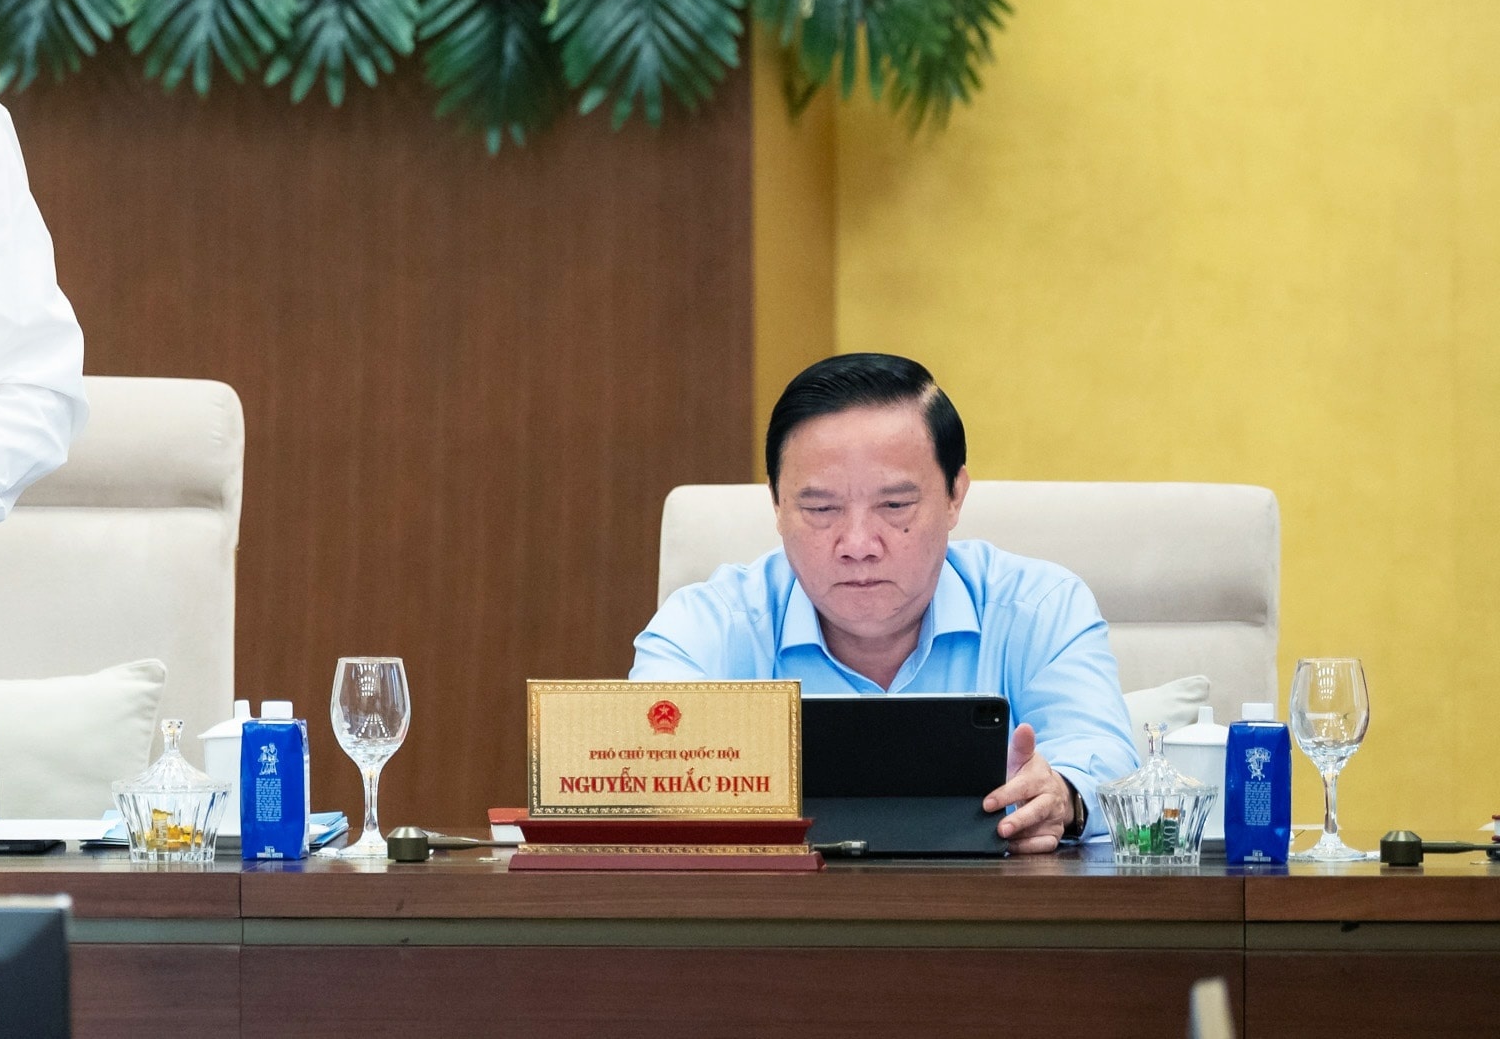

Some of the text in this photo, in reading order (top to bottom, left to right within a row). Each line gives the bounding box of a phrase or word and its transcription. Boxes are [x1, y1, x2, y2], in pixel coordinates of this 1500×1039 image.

[589, 746, 741, 762] PHÓ CHỦ TỊCH QUỐC HỘI
[559, 766, 770, 797] NGUYỄN KHẮC ĐỊNH
